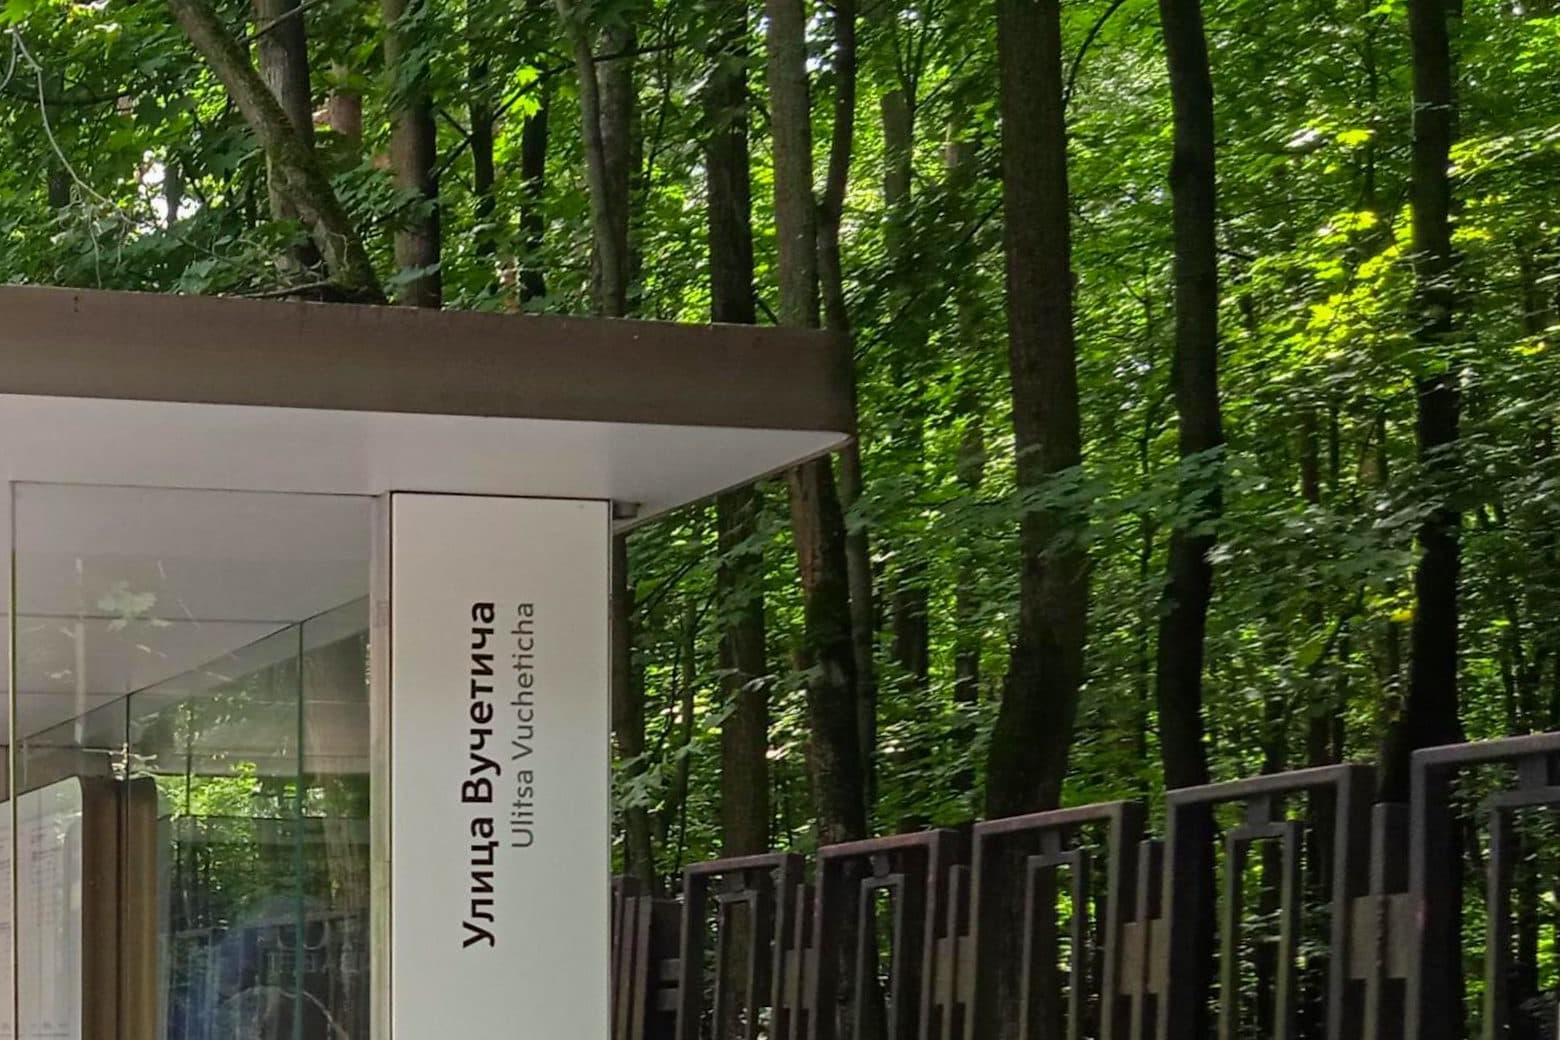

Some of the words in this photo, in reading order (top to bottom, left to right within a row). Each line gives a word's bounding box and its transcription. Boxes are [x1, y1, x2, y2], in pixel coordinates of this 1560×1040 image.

[461, 601, 501, 803] Вучетича
[511, 602, 534, 760] Vucheticha
[511, 769, 534, 848] Ulitsa
[463, 817, 499, 948] Улица
